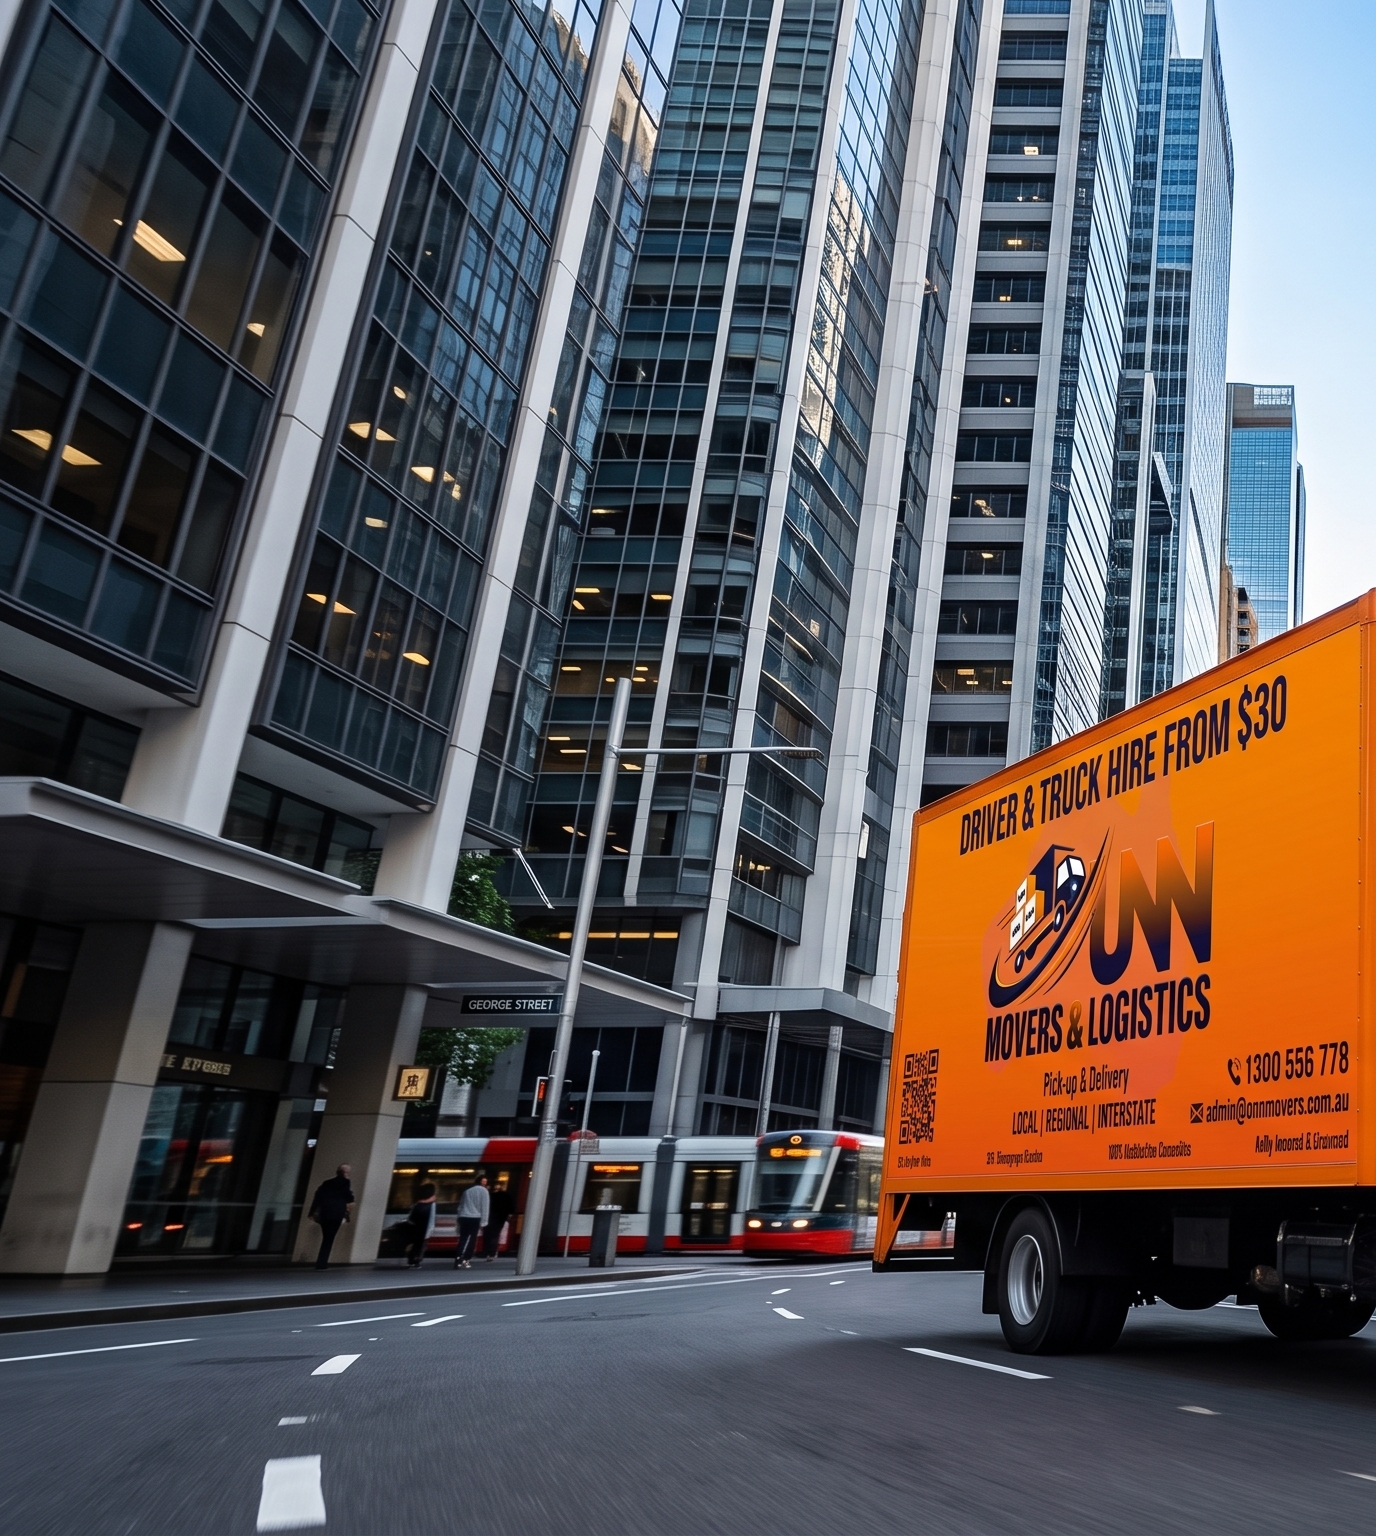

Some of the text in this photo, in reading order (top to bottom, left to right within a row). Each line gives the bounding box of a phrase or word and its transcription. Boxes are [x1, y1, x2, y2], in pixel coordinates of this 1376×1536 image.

[959, 675, 1288, 856] DRIVER & TRUCK HIRE FROM $30
[468, 999, 554, 1010] GEORGE STREET
[984, 974, 1211, 1063] MOVERS & LOGISTICS
[1246, 1041, 1349, 1085] 1300 556 778
[1043, 1064, 1130, 1101] Pick-up & Delivery
[1012, 1110, 1038, 1135] LOCAL
[1045, 1105, 1089, 1133] REGIONAL
[1097, 1099, 1156, 1129] INTERSTATE
[1206, 1093, 1349, 1125] admin@onnmovers.com.au
